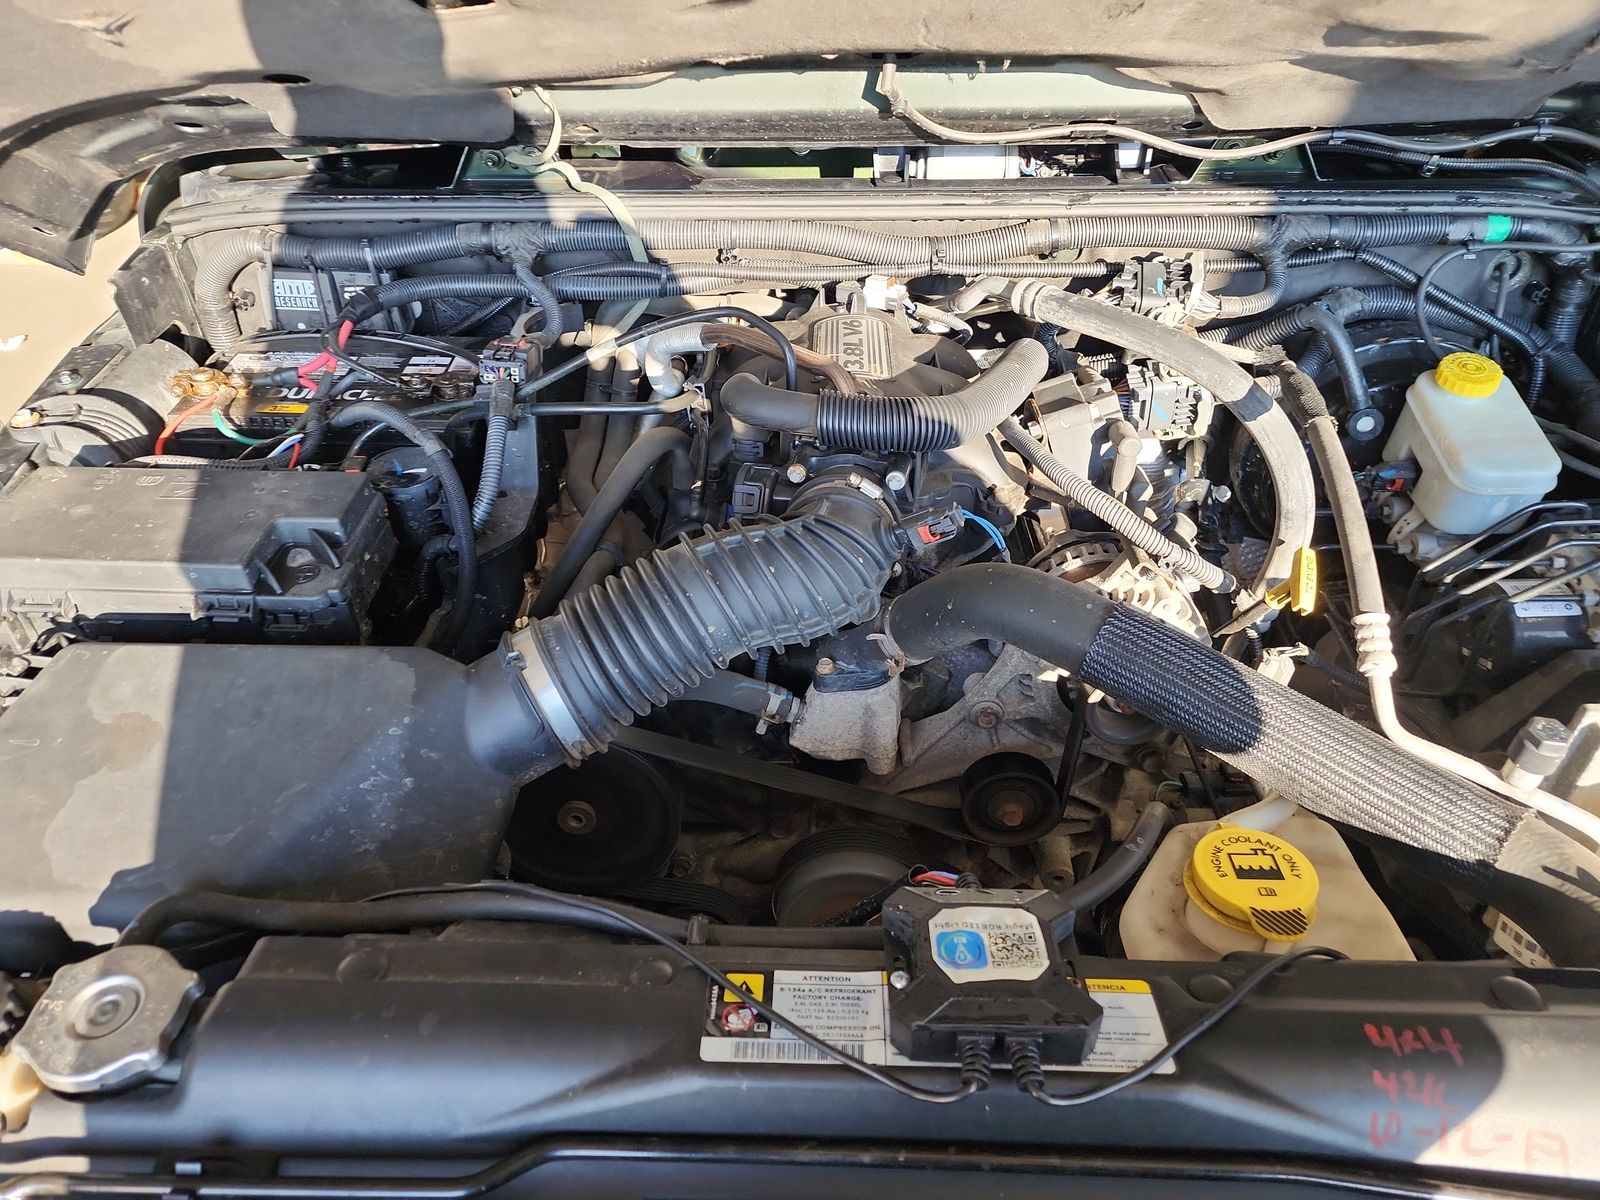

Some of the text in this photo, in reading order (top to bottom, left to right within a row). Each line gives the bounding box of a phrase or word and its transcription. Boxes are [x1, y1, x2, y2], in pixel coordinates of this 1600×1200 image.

[274, 296, 320, 308] RESEARCH
[841, 319, 865, 370] 3.8L V6
[1211, 835, 1303, 880] ENGINE COOLANT ONLY
[961, 921, 979, 929] LED
[1005, 922, 1034, 931] Magic
[801, 975, 851, 983] ATTENTION
